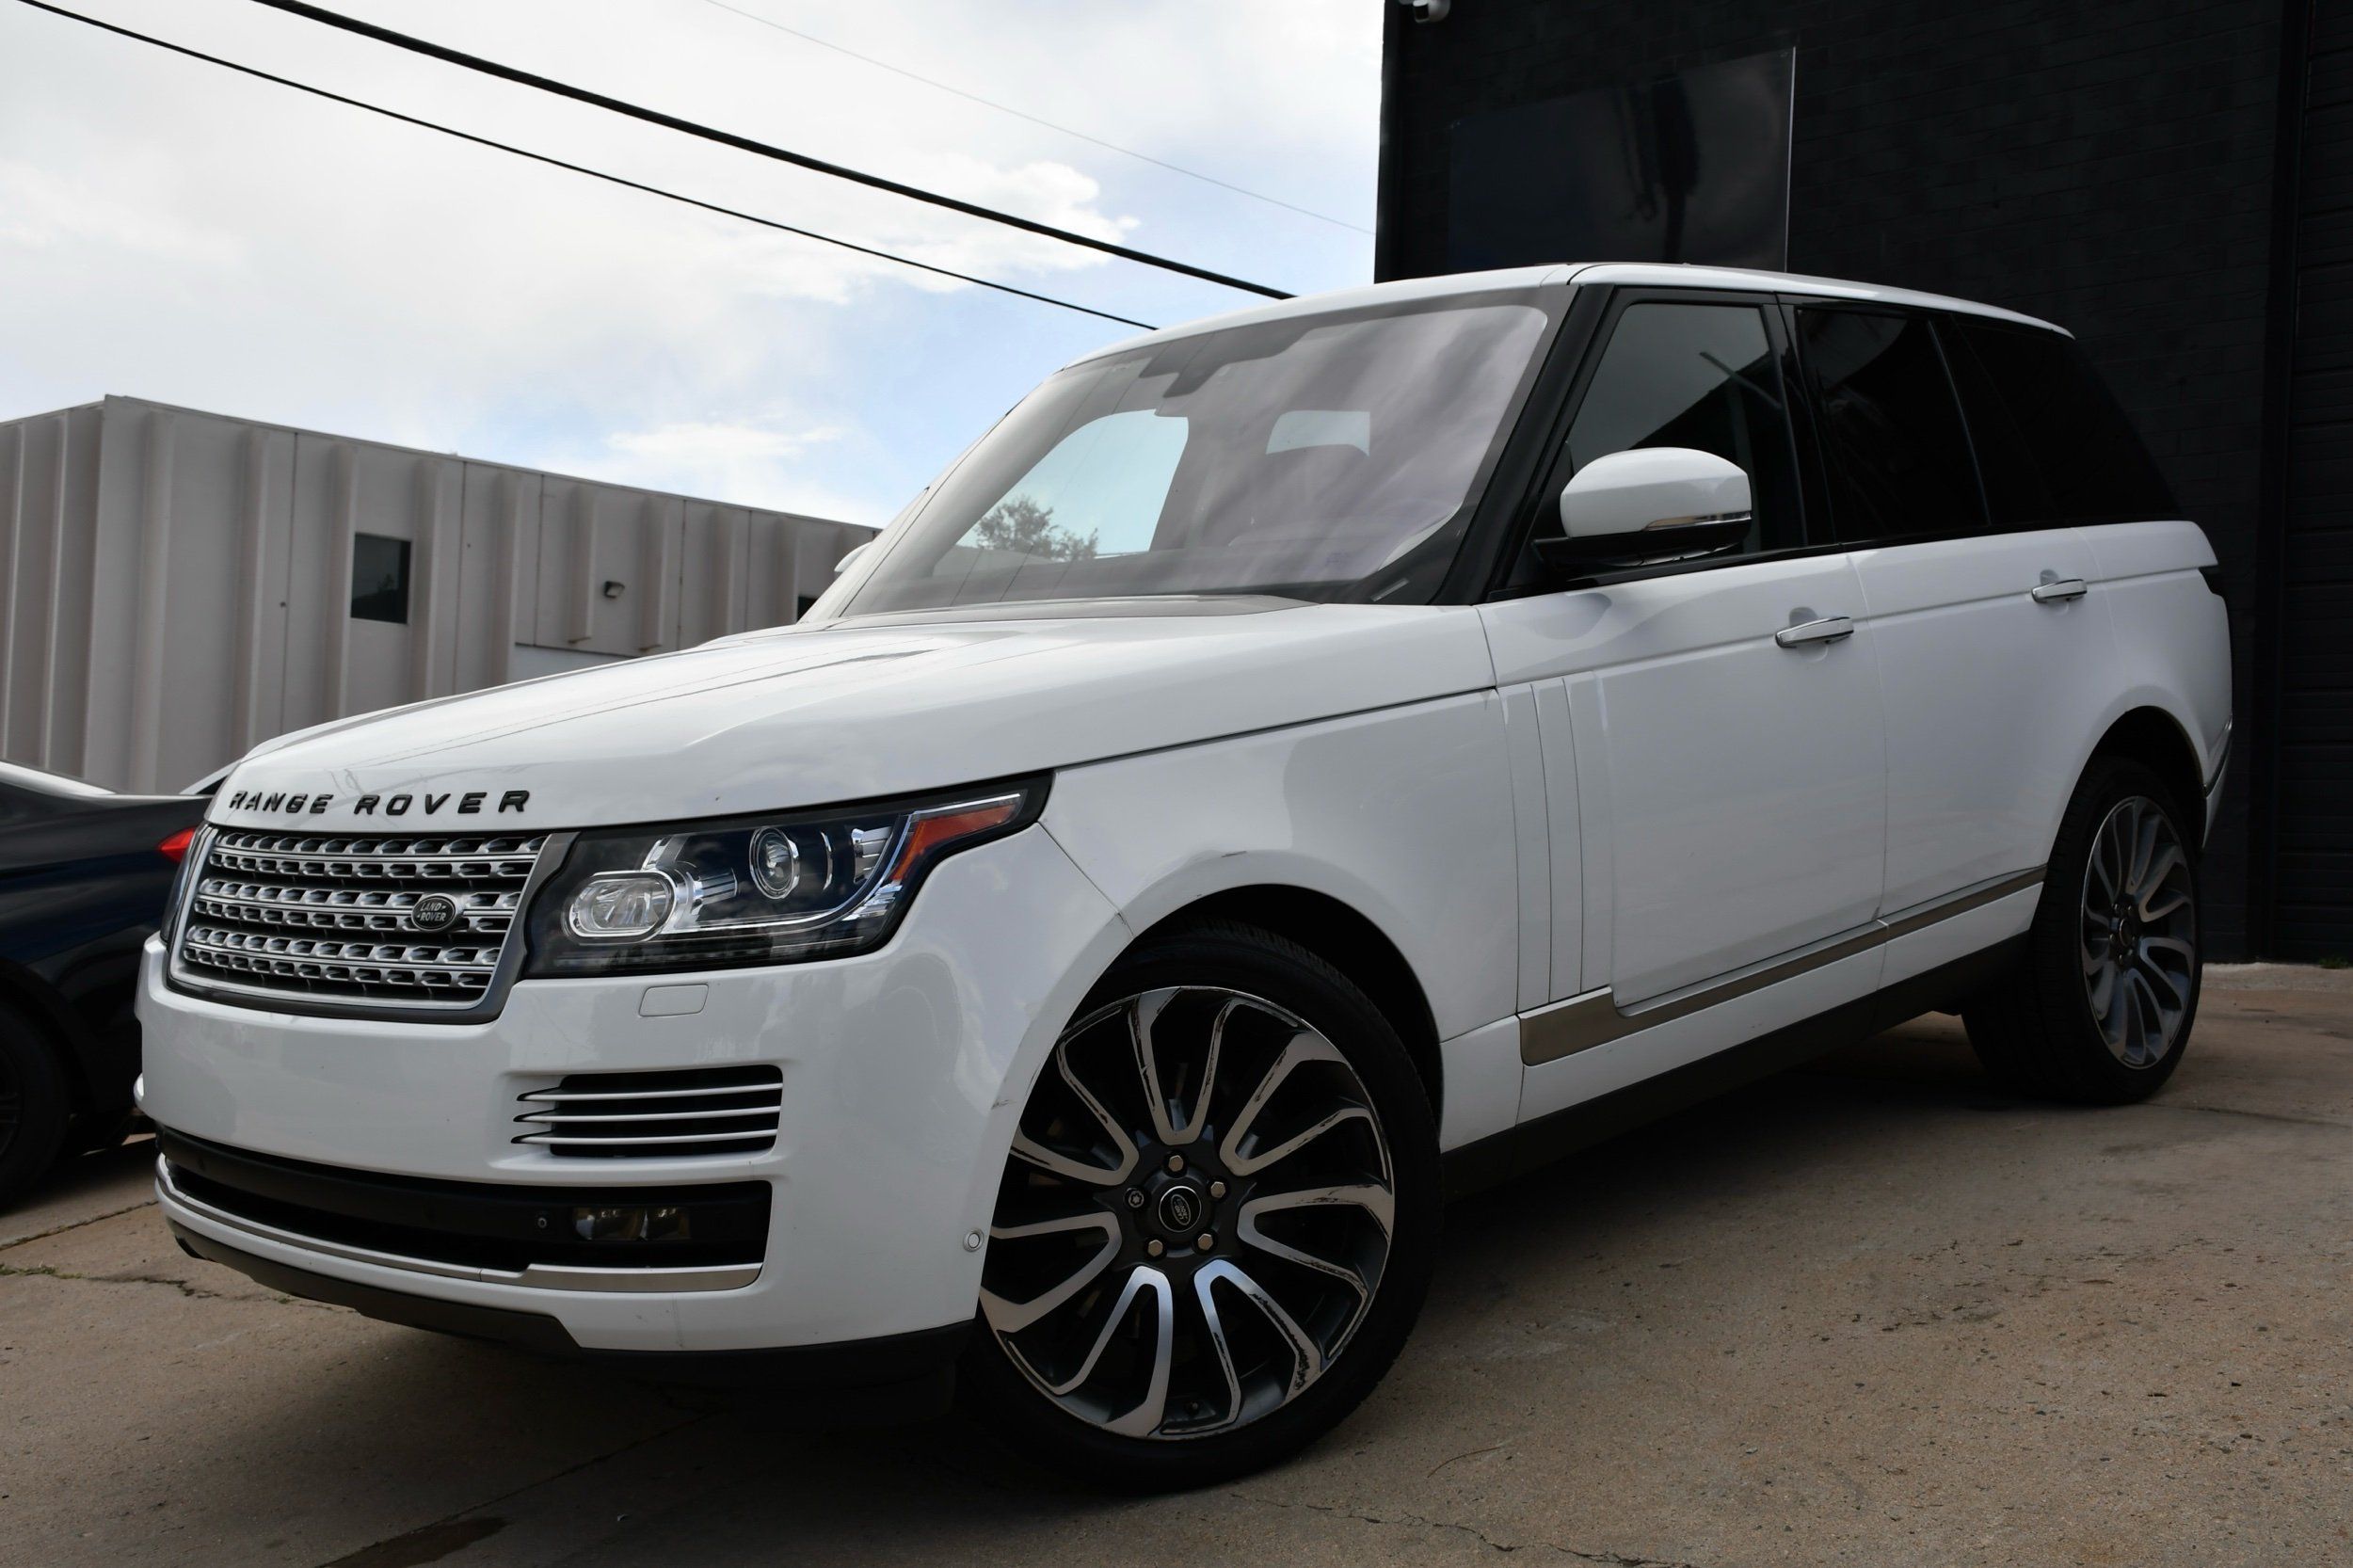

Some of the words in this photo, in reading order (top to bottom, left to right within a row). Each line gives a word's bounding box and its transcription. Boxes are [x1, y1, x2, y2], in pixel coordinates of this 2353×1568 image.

[229, 791, 334, 814] RANGE
[353, 790, 530, 816] ROVER
[420, 903, 442, 912] LAND
[420, 912, 447, 921] ROVER
